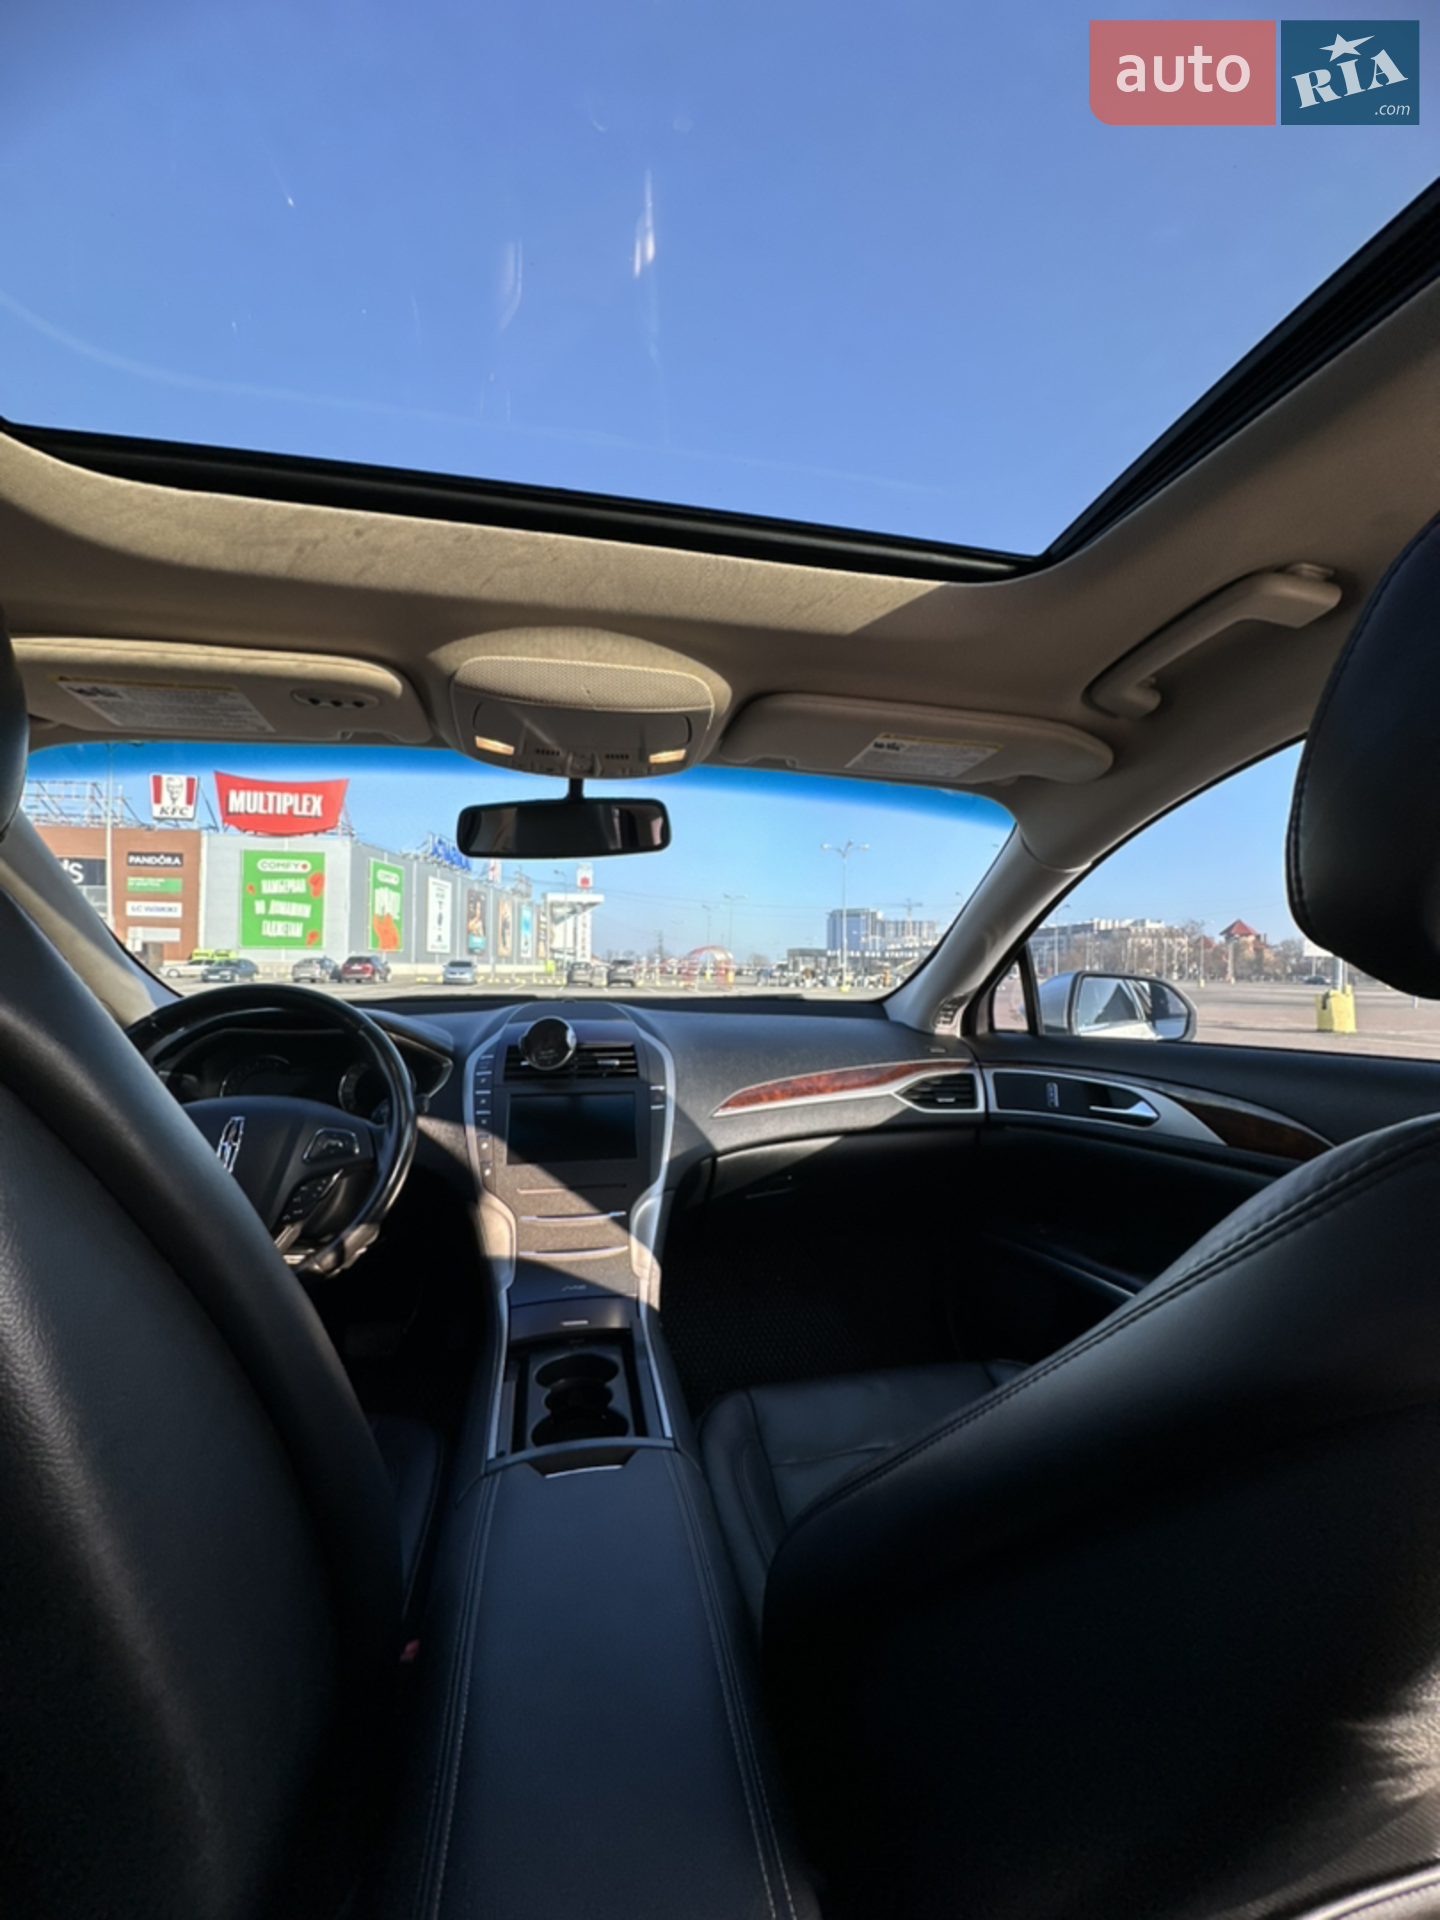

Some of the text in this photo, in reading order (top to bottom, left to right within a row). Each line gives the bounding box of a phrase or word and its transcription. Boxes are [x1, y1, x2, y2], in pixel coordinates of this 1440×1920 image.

[228, 789, 324, 818] MULTIPLEX
[159, 806, 190, 816] KFC
[129, 855, 181, 865] PANDORA
[261, 861, 300, 870] COMFY
